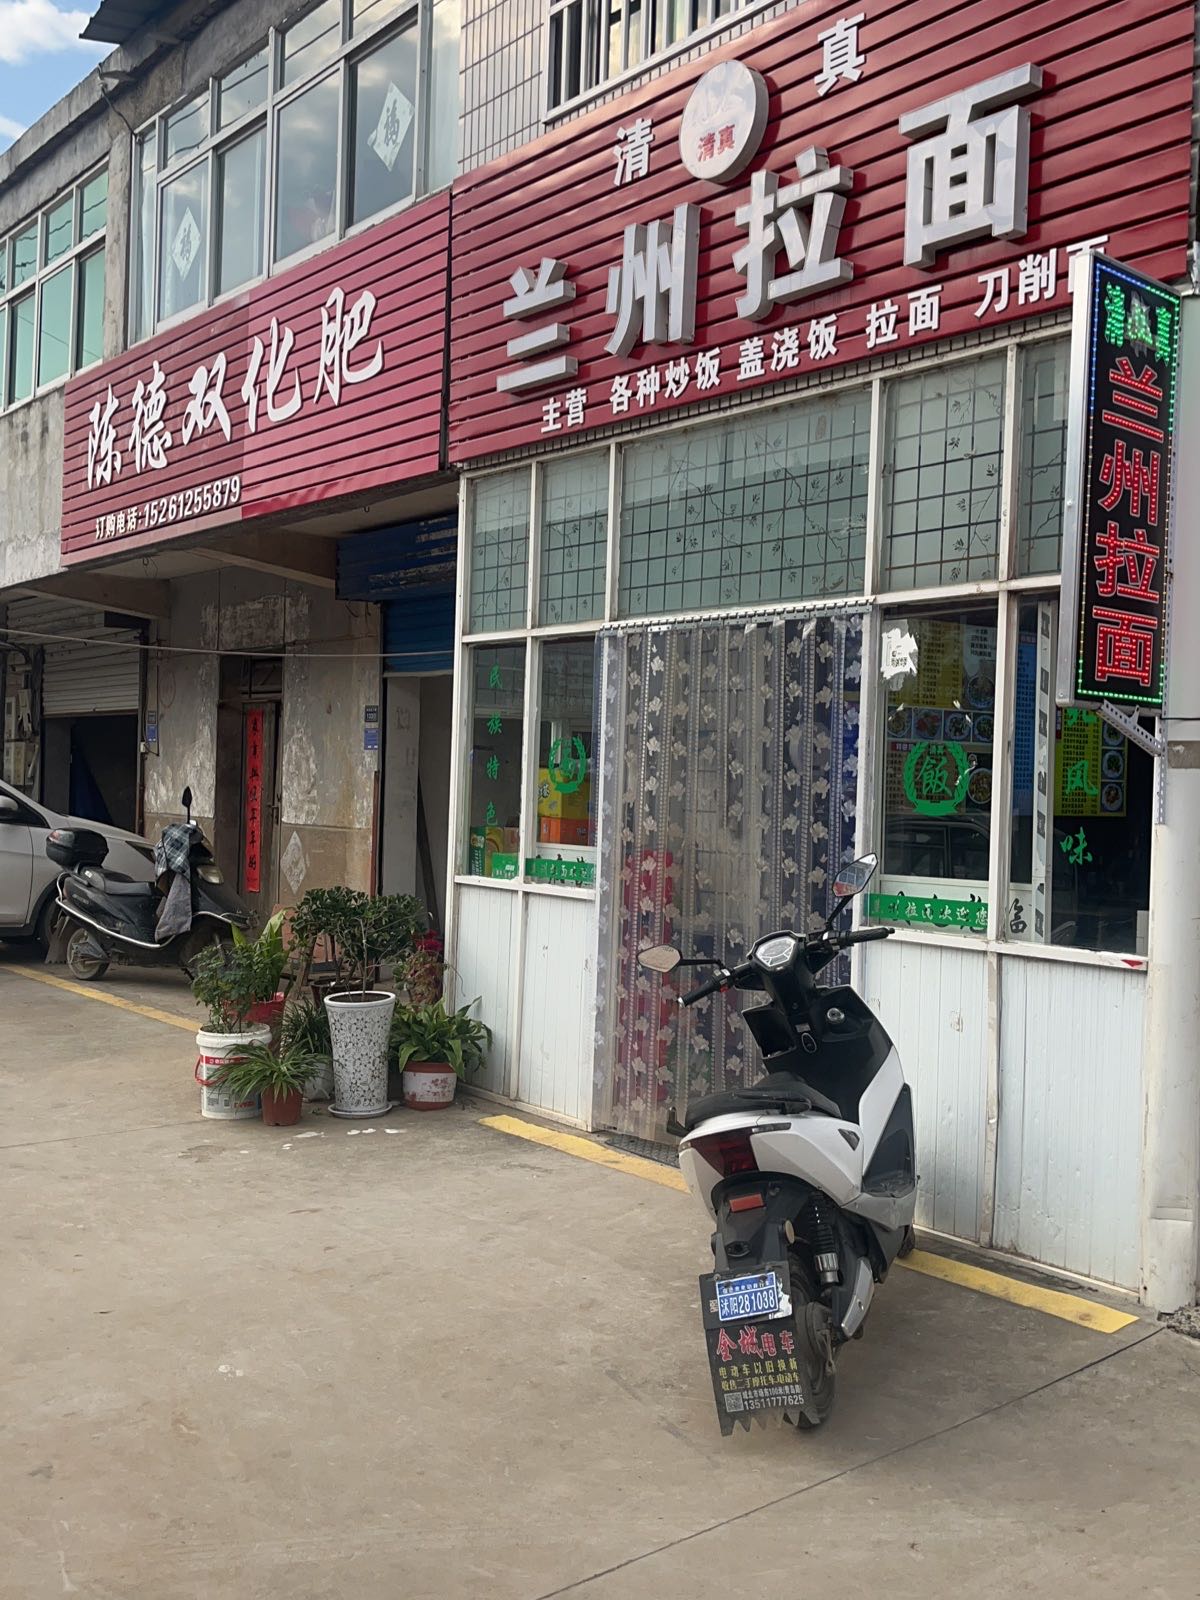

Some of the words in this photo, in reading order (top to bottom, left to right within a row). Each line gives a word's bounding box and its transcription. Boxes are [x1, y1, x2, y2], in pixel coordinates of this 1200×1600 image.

[613, 118, 654, 187] 清
[814, 12, 867, 96] 真
[697, 124, 735, 162] 清真
[497, 62, 1042, 393] 兰州拉面
[87, 286, 384, 490] 陈德双化肥
[541, 388, 587, 434] 主营
[610, 347, 721, 415] 各种炒饭
[736, 314, 838, 382] 盖浇饭
[866, 285, 942, 349] 拉面
[1092, 356, 1164, 688] 兰州拉面
[486, 664, 503, 826] 民族特色
